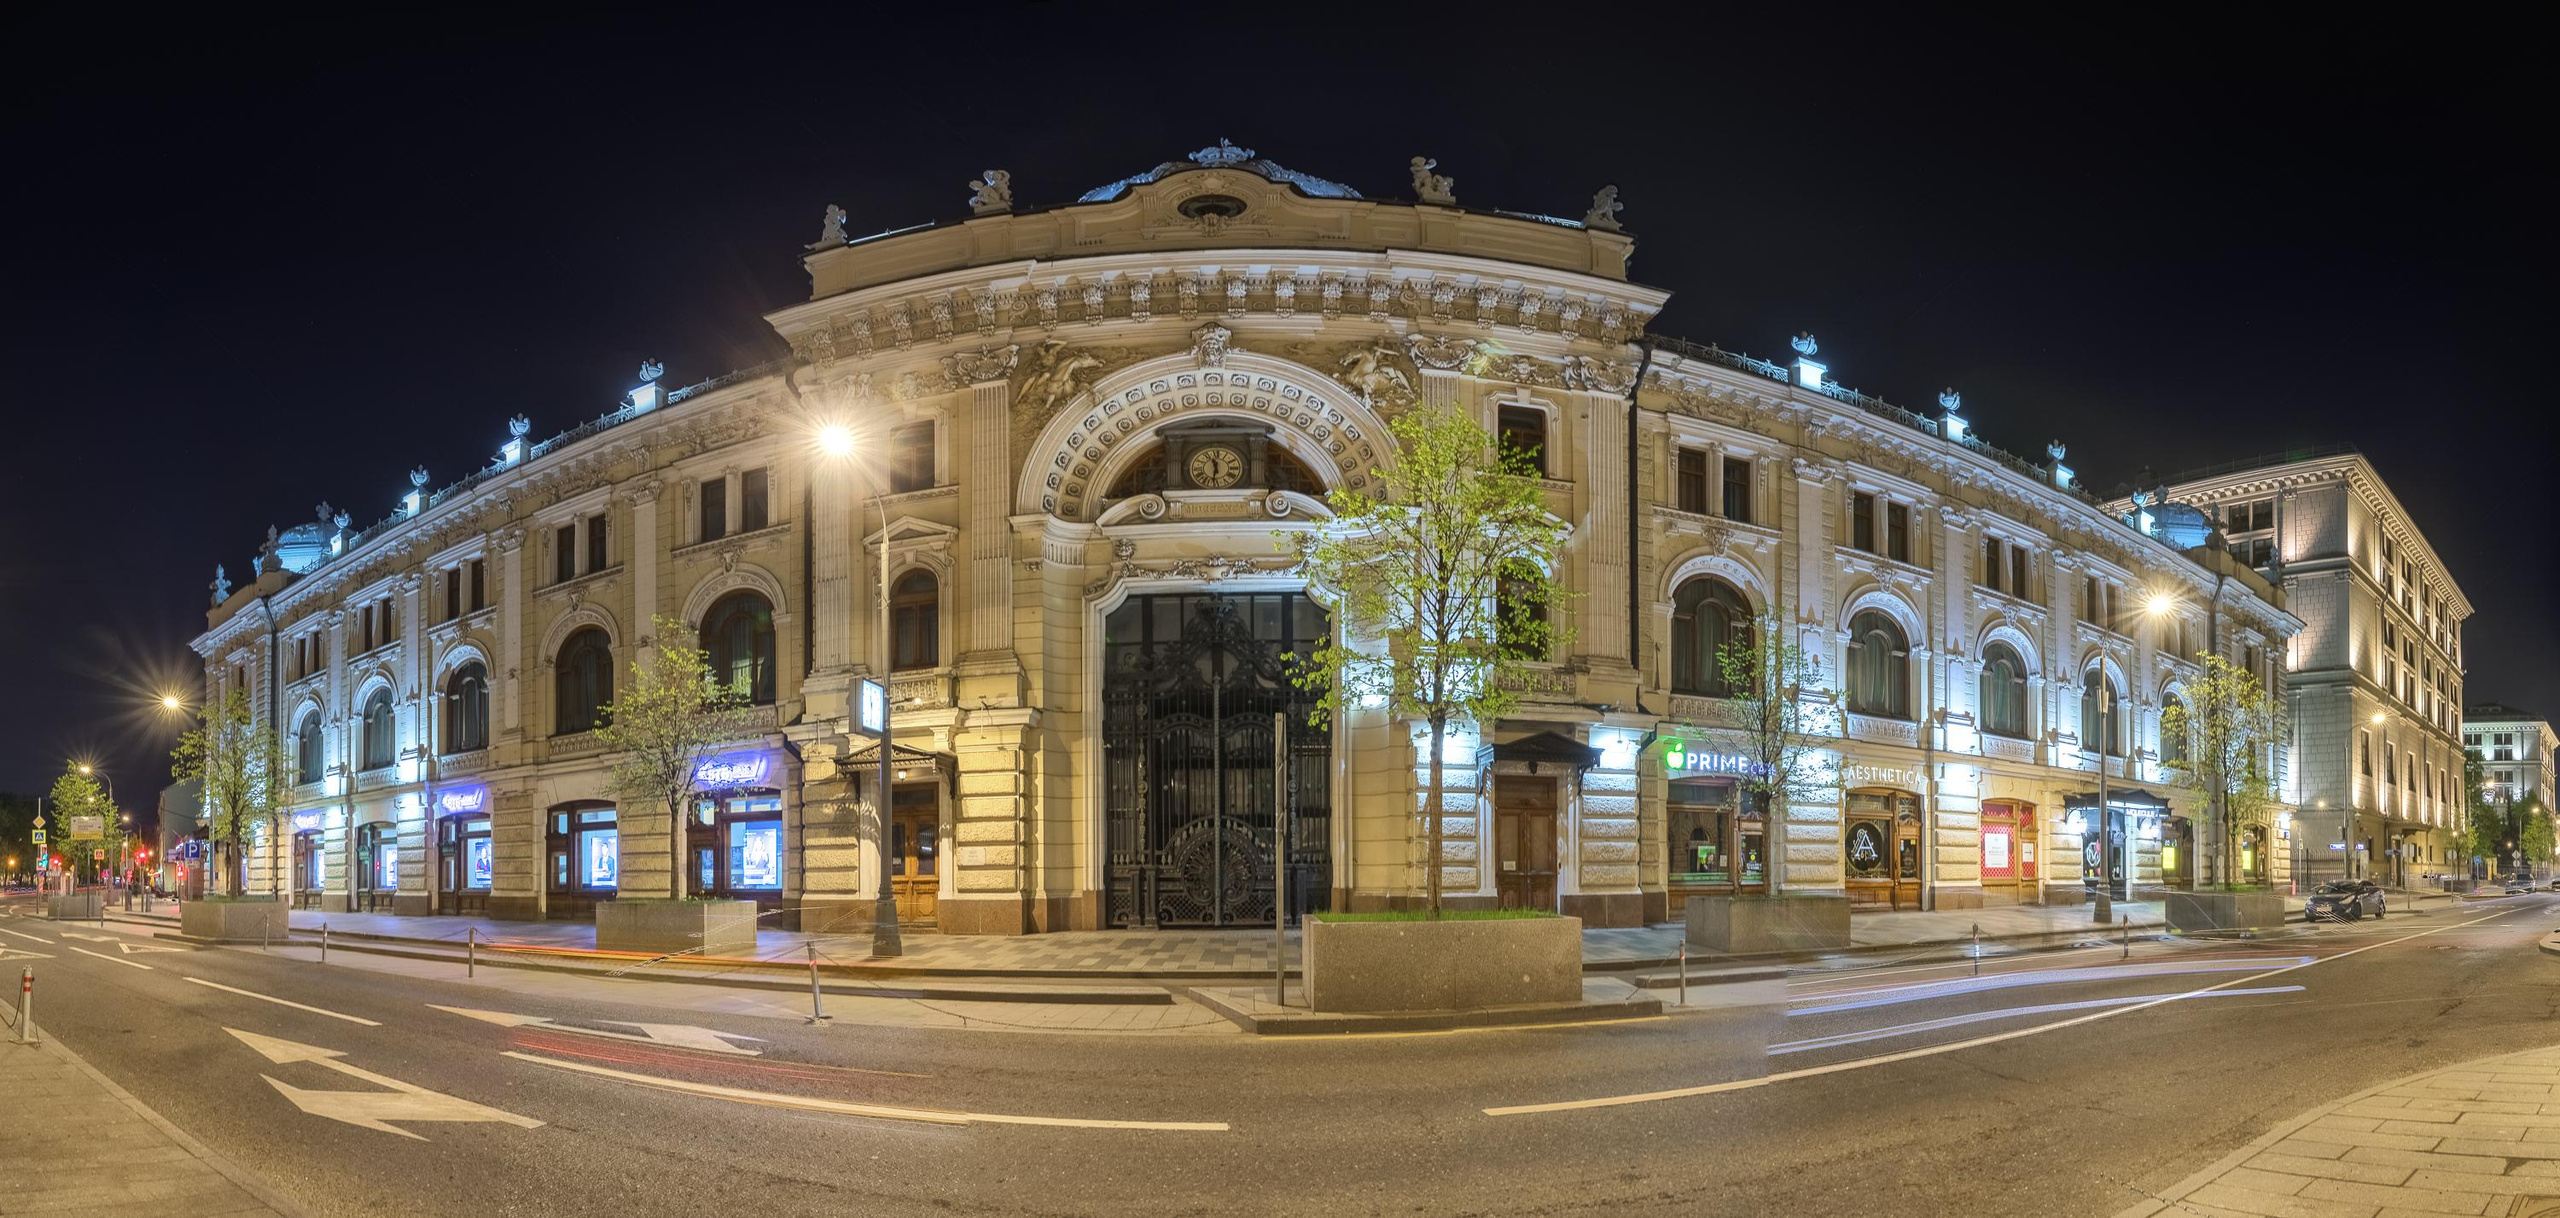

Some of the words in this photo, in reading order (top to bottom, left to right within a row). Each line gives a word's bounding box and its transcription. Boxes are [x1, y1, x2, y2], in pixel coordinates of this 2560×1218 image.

[1687, 753, 1748, 773] PRIME
[1848, 766, 1921, 784] AESTHETICA
[189, 844, 198, 857] P
